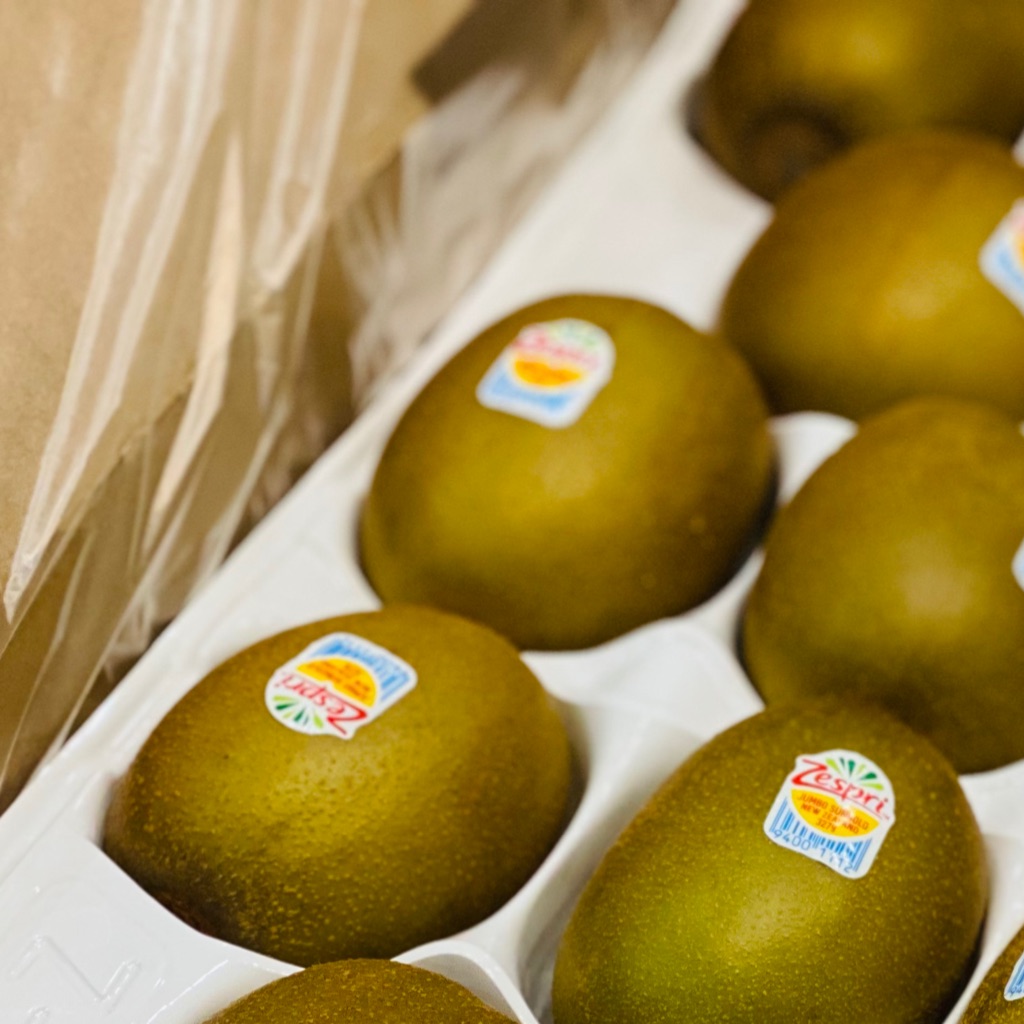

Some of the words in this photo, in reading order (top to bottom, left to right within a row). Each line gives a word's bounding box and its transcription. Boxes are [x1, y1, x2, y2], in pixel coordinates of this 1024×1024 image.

[275, 673, 367, 735] Zespri
[791, 759, 888, 819] Zespri
[797, 793, 828, 809] JUMBO
[830, 805, 869, 829] SUNOLD
[801, 803, 820, 814] NEW
[822, 810, 859, 834] ZEAAND
[816, 819, 837, 832] 3279
[773, 830, 811, 850] 9400
